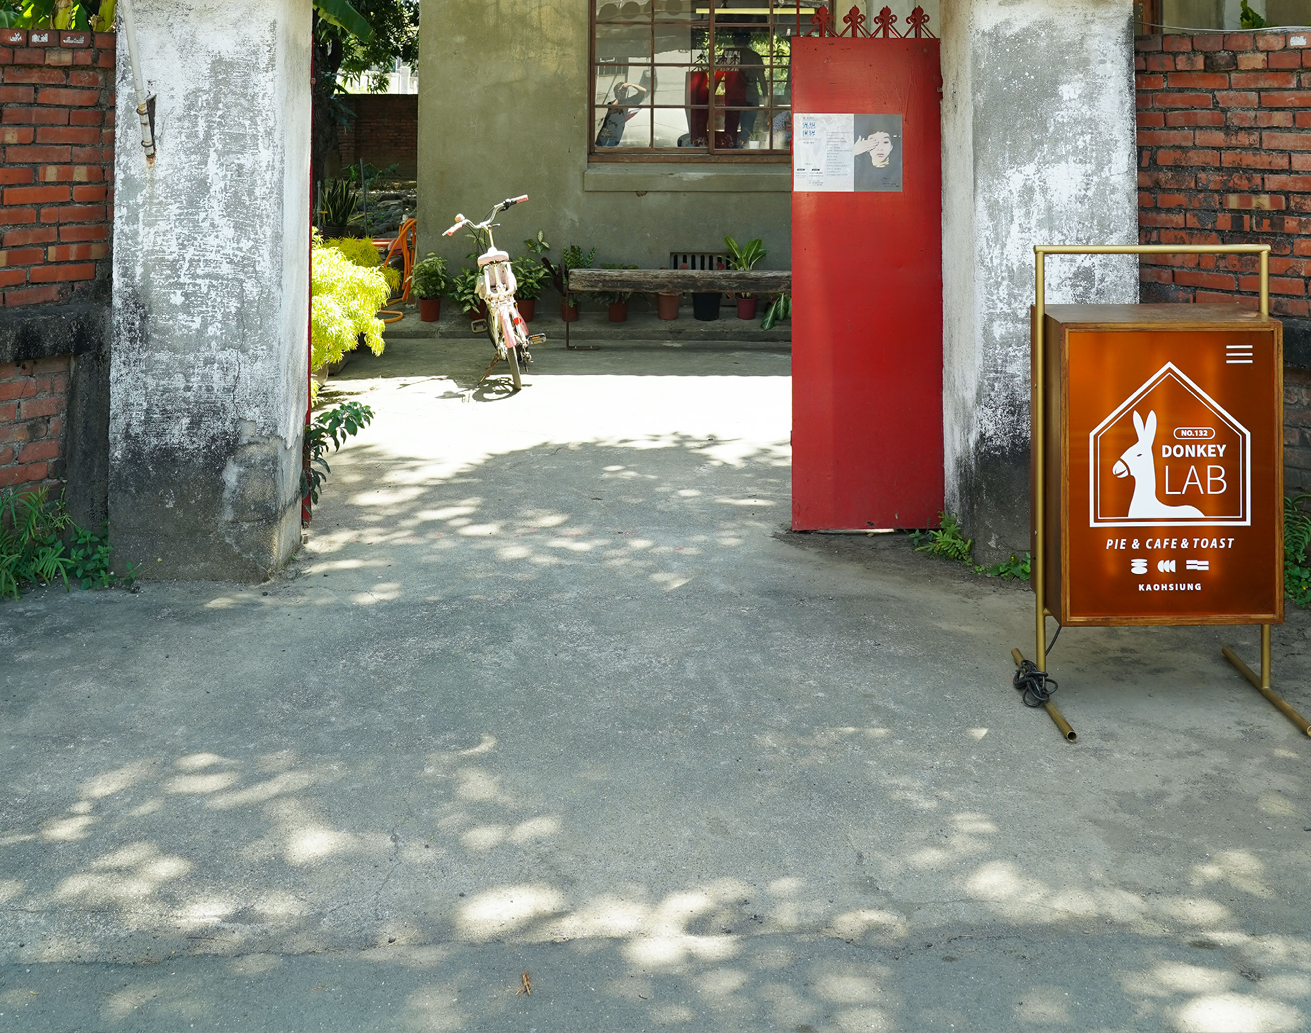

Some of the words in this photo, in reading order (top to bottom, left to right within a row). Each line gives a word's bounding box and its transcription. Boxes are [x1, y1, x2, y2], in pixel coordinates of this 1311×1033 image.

[1180, 429, 1208, 437] NO.132
[1161, 444, 1227, 458] DONKEY
[1165, 464, 1227, 495] LAB
[1105, 538, 1127, 550] PIE
[1131, 538, 1141, 550] &
[1145, 538, 1178, 550] CAFE
[1180, 538, 1190, 550] &
[1192, 538, 1235, 550] TOAST
[1138, 583, 1202, 592] KAOHSIUNG
